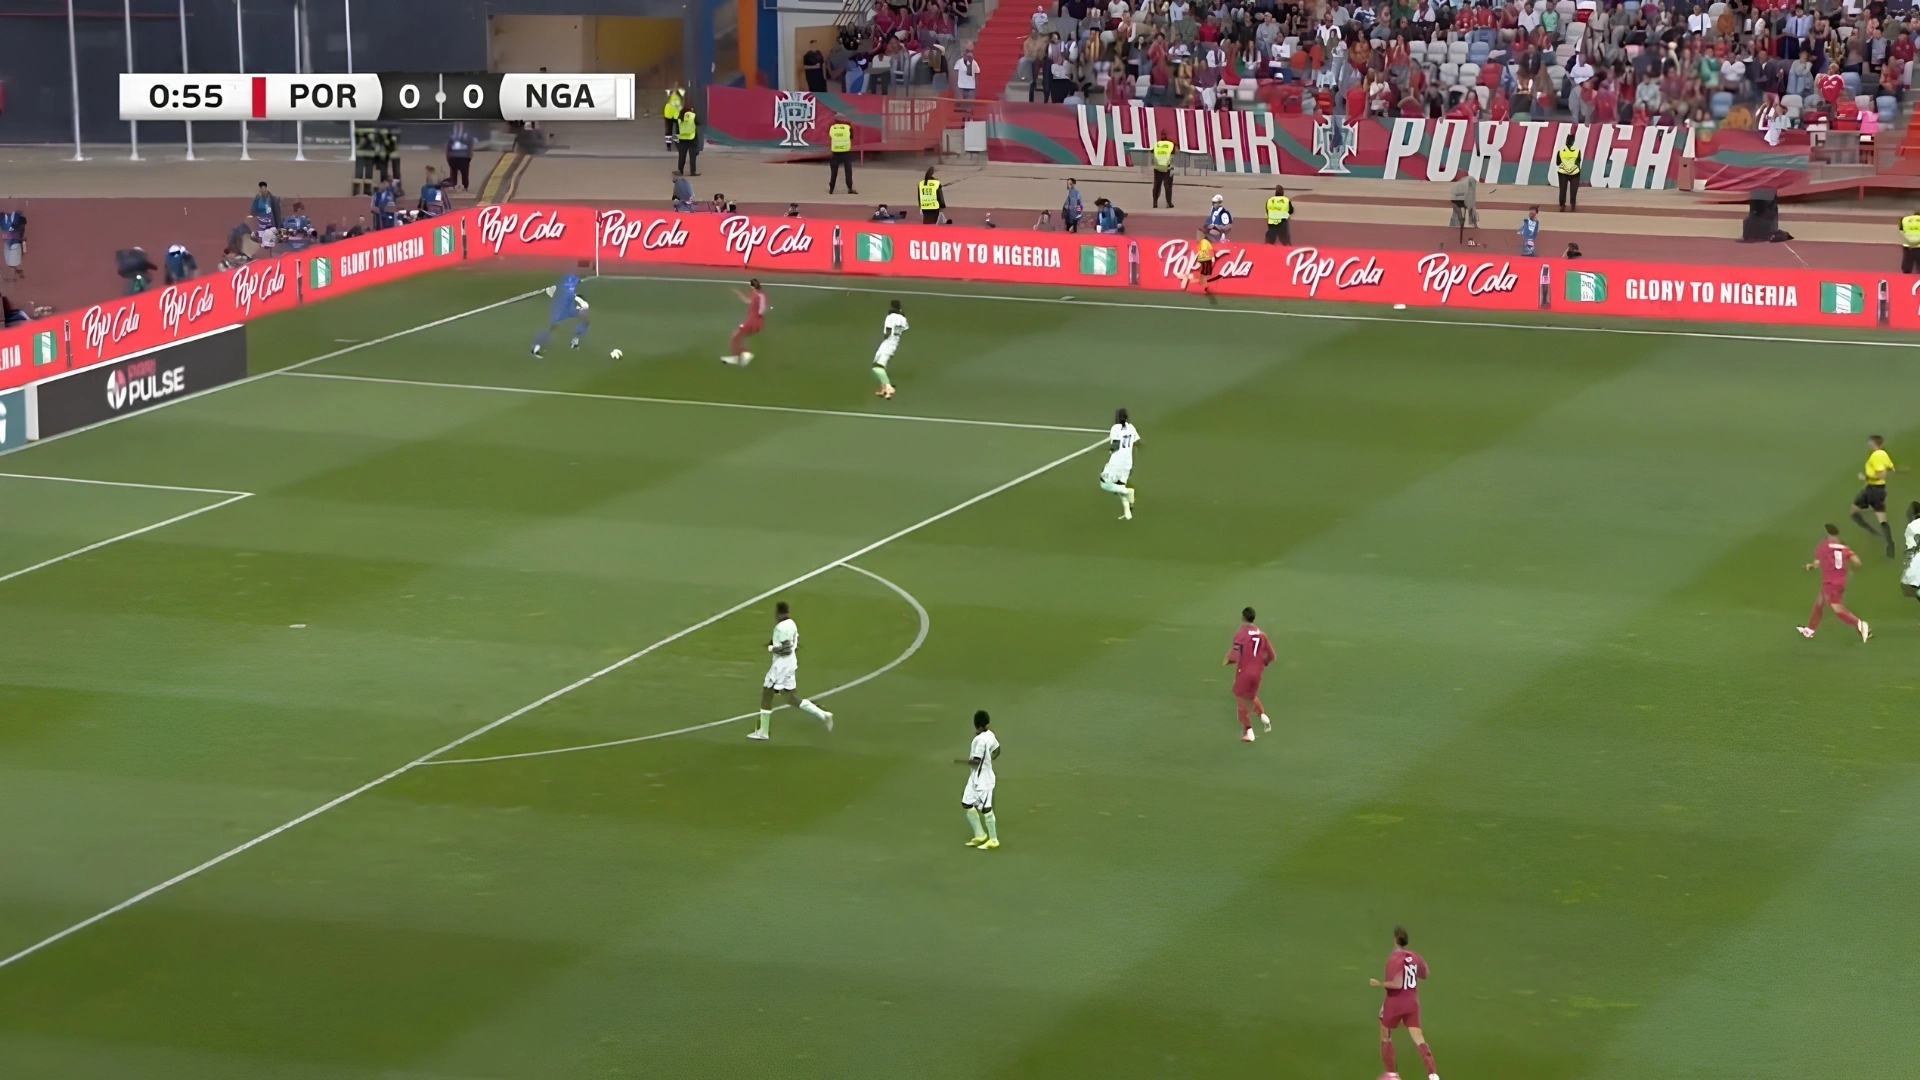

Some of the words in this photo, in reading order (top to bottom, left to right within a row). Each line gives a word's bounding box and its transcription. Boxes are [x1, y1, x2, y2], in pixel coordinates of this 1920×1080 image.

[478, 206, 518, 253] Pop
[520, 211, 565, 243] Cola
[601, 209, 642, 258] Pop
[643, 219, 689, 249] Cola
[720, 216, 767, 264] Pop
[767, 223, 813, 255] Cola
[909, 239, 962, 263] GLORY
[966, 243, 988, 264] TO
[992, 244, 1061, 268] NIGERIA
[1286, 247, 1335, 297] Pop
[1336, 256, 1385, 288] Cola
[1417, 253, 1467, 303] Pop
[1468, 262, 1518, 295] Cola
[1625, 278, 1685, 302] GLORY
[1689, 281, 1714, 303] TO
[1720, 282, 1798, 307] NIGERIA
[129, 365, 186, 407] PULSE
[1251, 637, 1260, 658] 7
